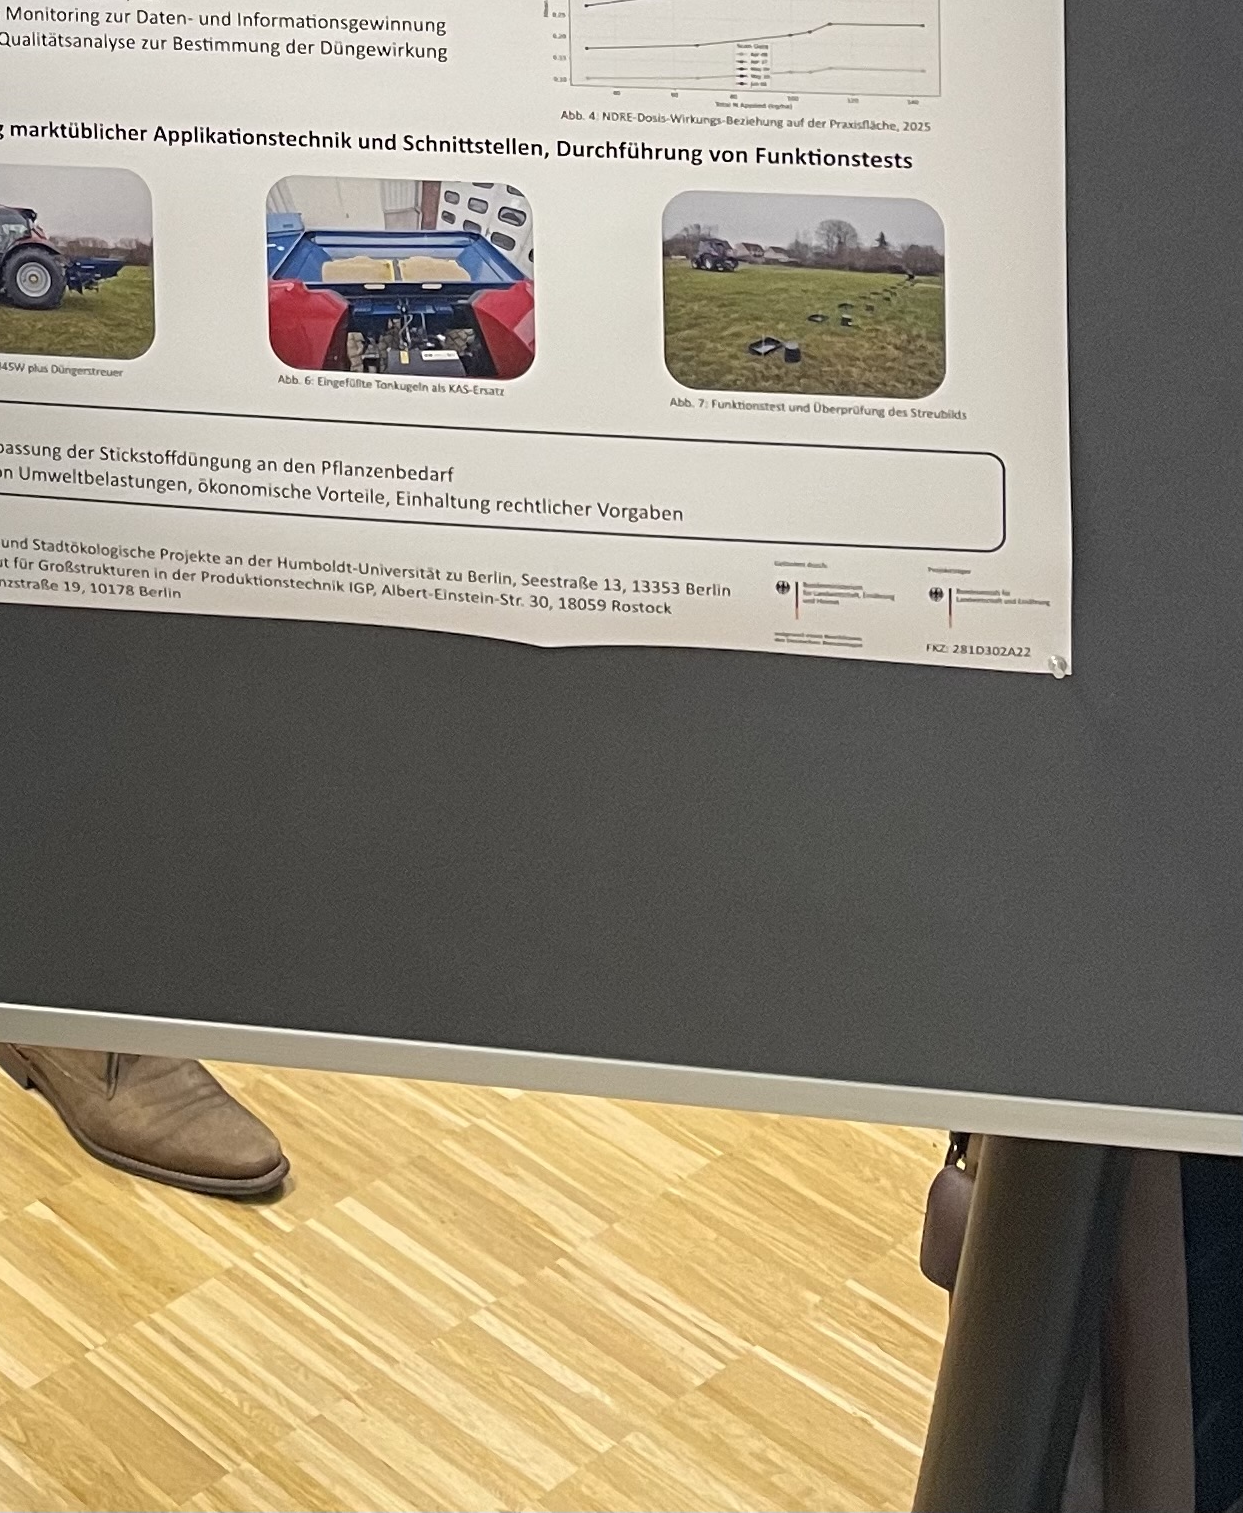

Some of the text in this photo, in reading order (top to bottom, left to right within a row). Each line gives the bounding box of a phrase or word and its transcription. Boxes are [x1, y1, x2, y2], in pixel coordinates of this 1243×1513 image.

[10, 120, 148, 142] marktüblicher
[153, 125, 353, 150] Applikationstechnik
[358, 133, 397, 151] und
[402, 134, 550, 160] Schnittstellen,
[556, 140, 703, 166] Durchführung
[708, 149, 748, 164] von
[756, 146, 913, 170] Funktionstests
[66, 443, 95, 461] der
[98, 445, 252, 474] Stickstoffdüngung
[256, 459, 278, 472] an
[282, 457, 316, 475] den
[321, 459, 455, 483] Pflanzenbedarf
[18, 465, 193, 495] Umweltbelastungen,
[197, 477, 312, 501] ökonomische
[316, 485, 390, 508] Vorteile,
[396, 490, 491, 515] Einhaltung
[496, 496, 593, 517] rechtlicher
[596, 501, 684, 523] Vorgaben
[64, 580, 85, 595] 19,
[91, 582, 135, 597] 10178
[139, 585, 181, 599] Berlin
[952, 644, 1031, 658] 281D302A22
